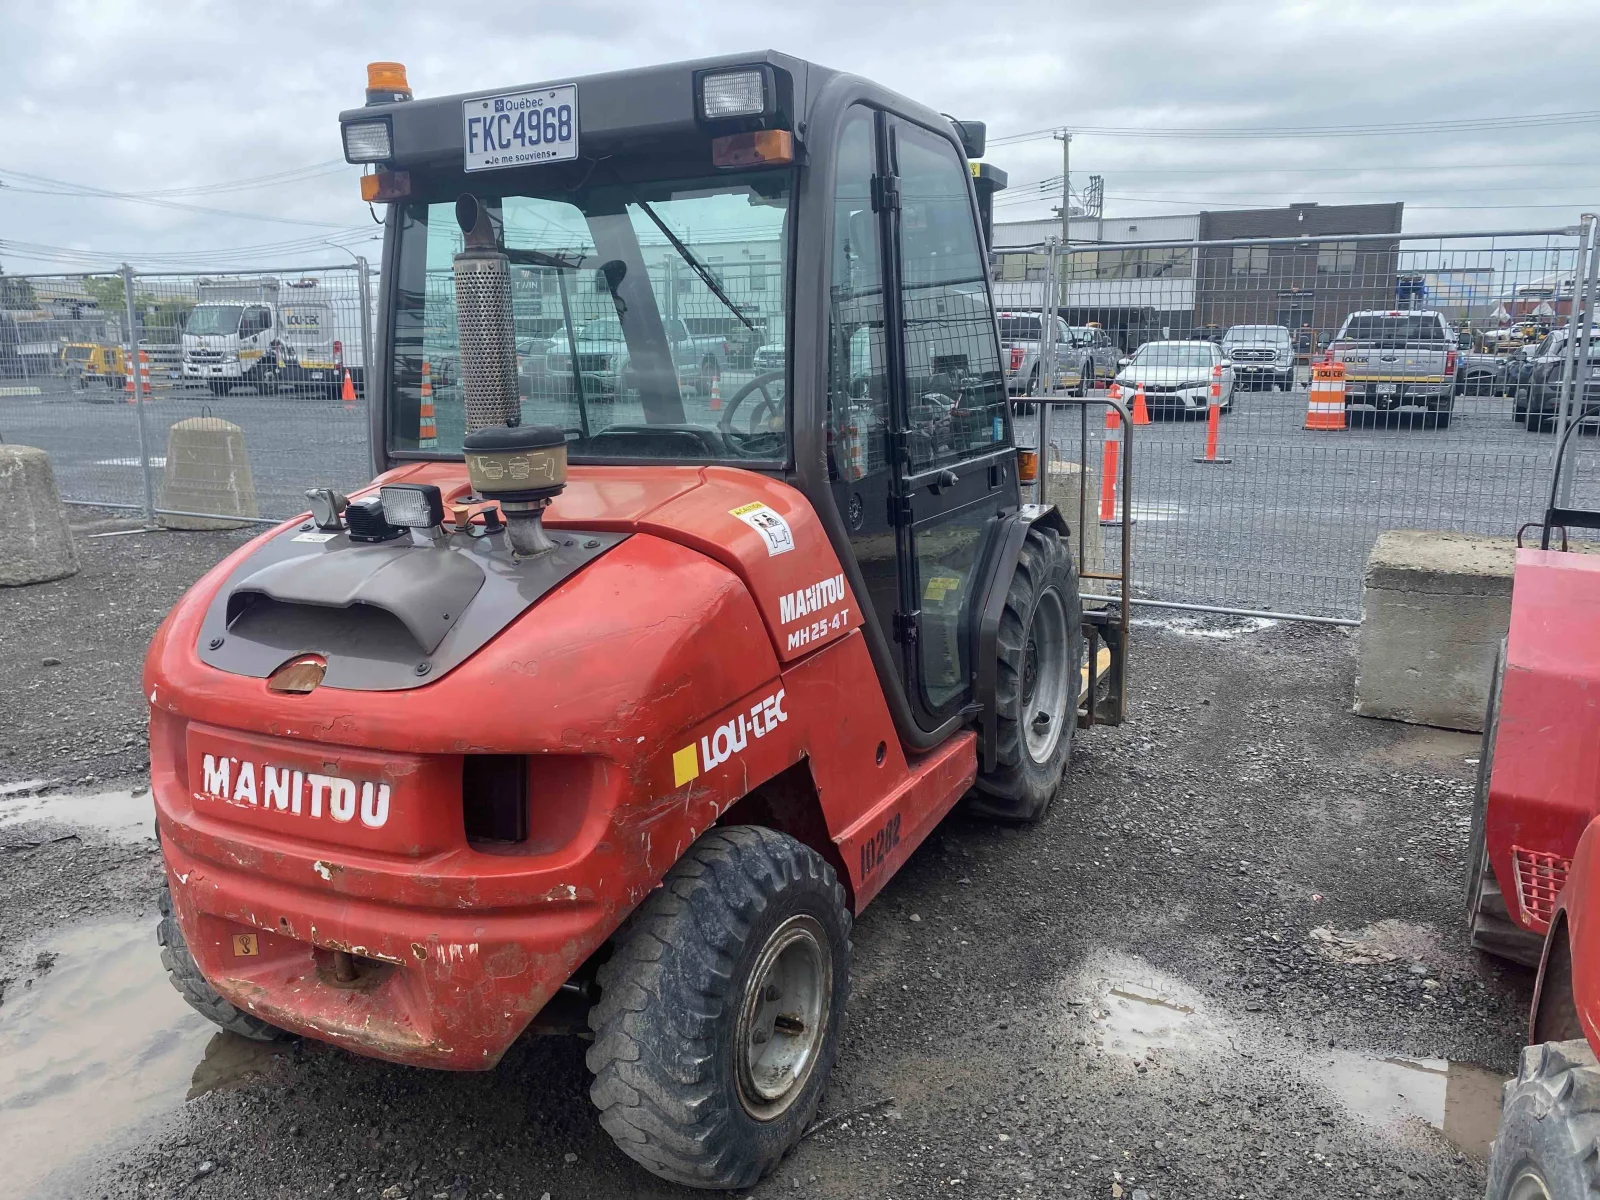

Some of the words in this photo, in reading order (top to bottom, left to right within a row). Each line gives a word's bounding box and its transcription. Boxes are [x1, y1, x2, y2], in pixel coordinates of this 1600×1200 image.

[468, 104, 572, 154] FKC4968
[505, 98, 543, 110] Québec
[490, 155, 499, 165] Je
[515, 150, 551, 162] souviens
[780, 574, 845, 625] MANITOU
[701, 688, 788, 773] LOU-TEC
[203, 754, 391, 828] MANITOU
